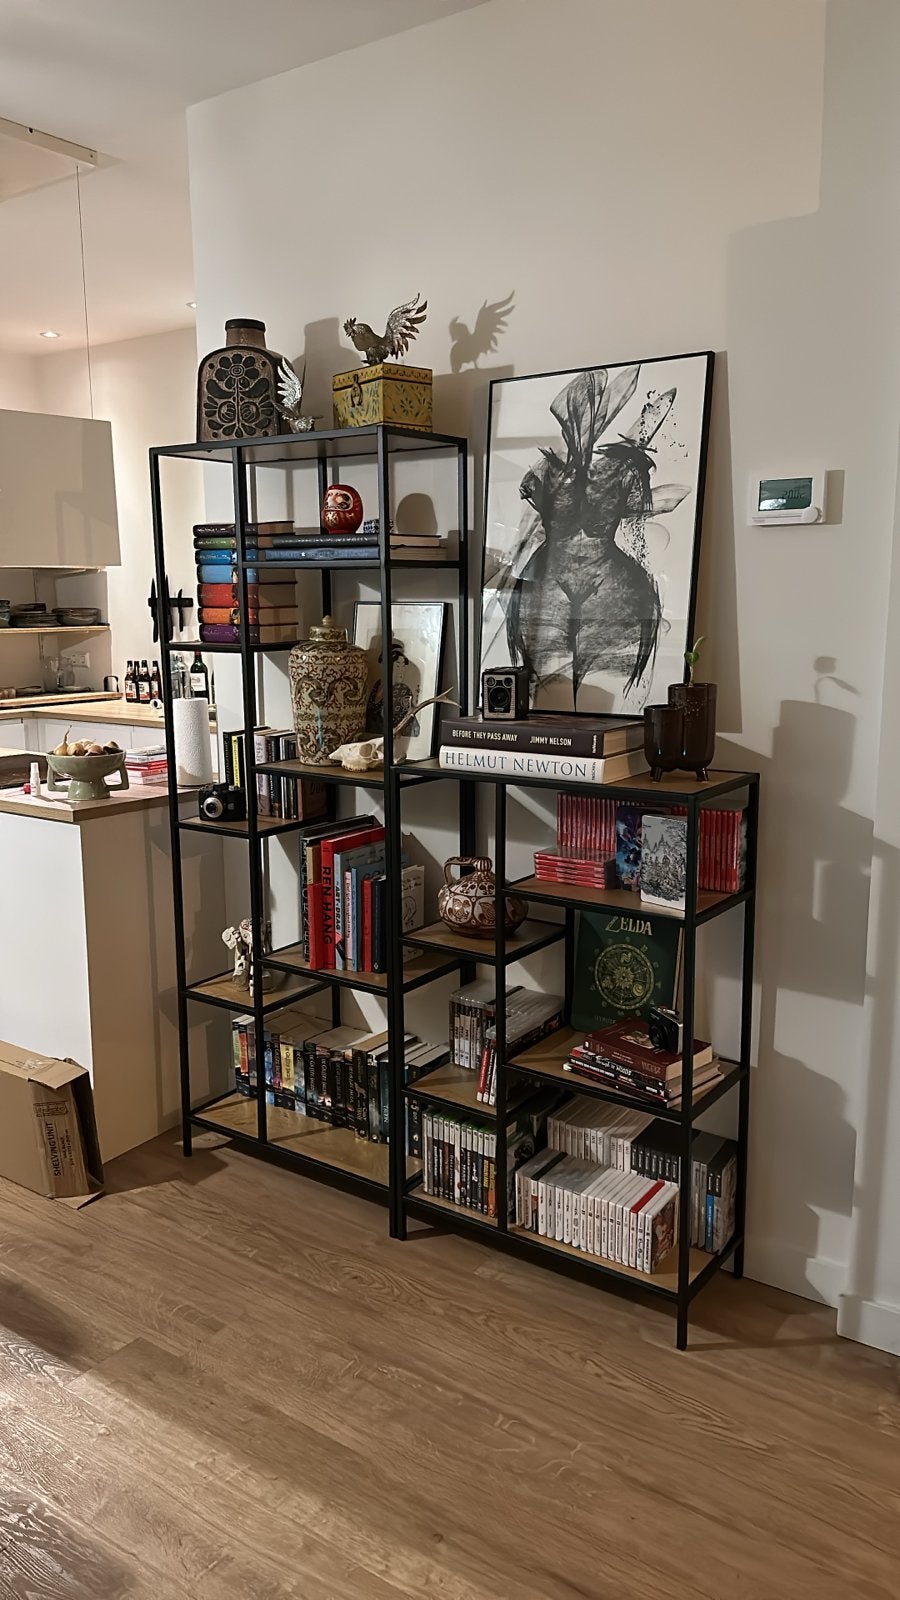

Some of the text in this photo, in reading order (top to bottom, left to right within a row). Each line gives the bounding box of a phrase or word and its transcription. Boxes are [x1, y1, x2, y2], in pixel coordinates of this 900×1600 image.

[452, 729, 518, 742] BEFORE THEY PASS AWAY
[529, 735, 572, 746] JIMMY NELSON
[445, 752, 587, 778] HELMUT NEWTON
[322, 866, 333, 945] REN HANG
[605, 916, 653, 936] ZELDA
[46, 1122, 62, 1177] SHELVING UNIT
